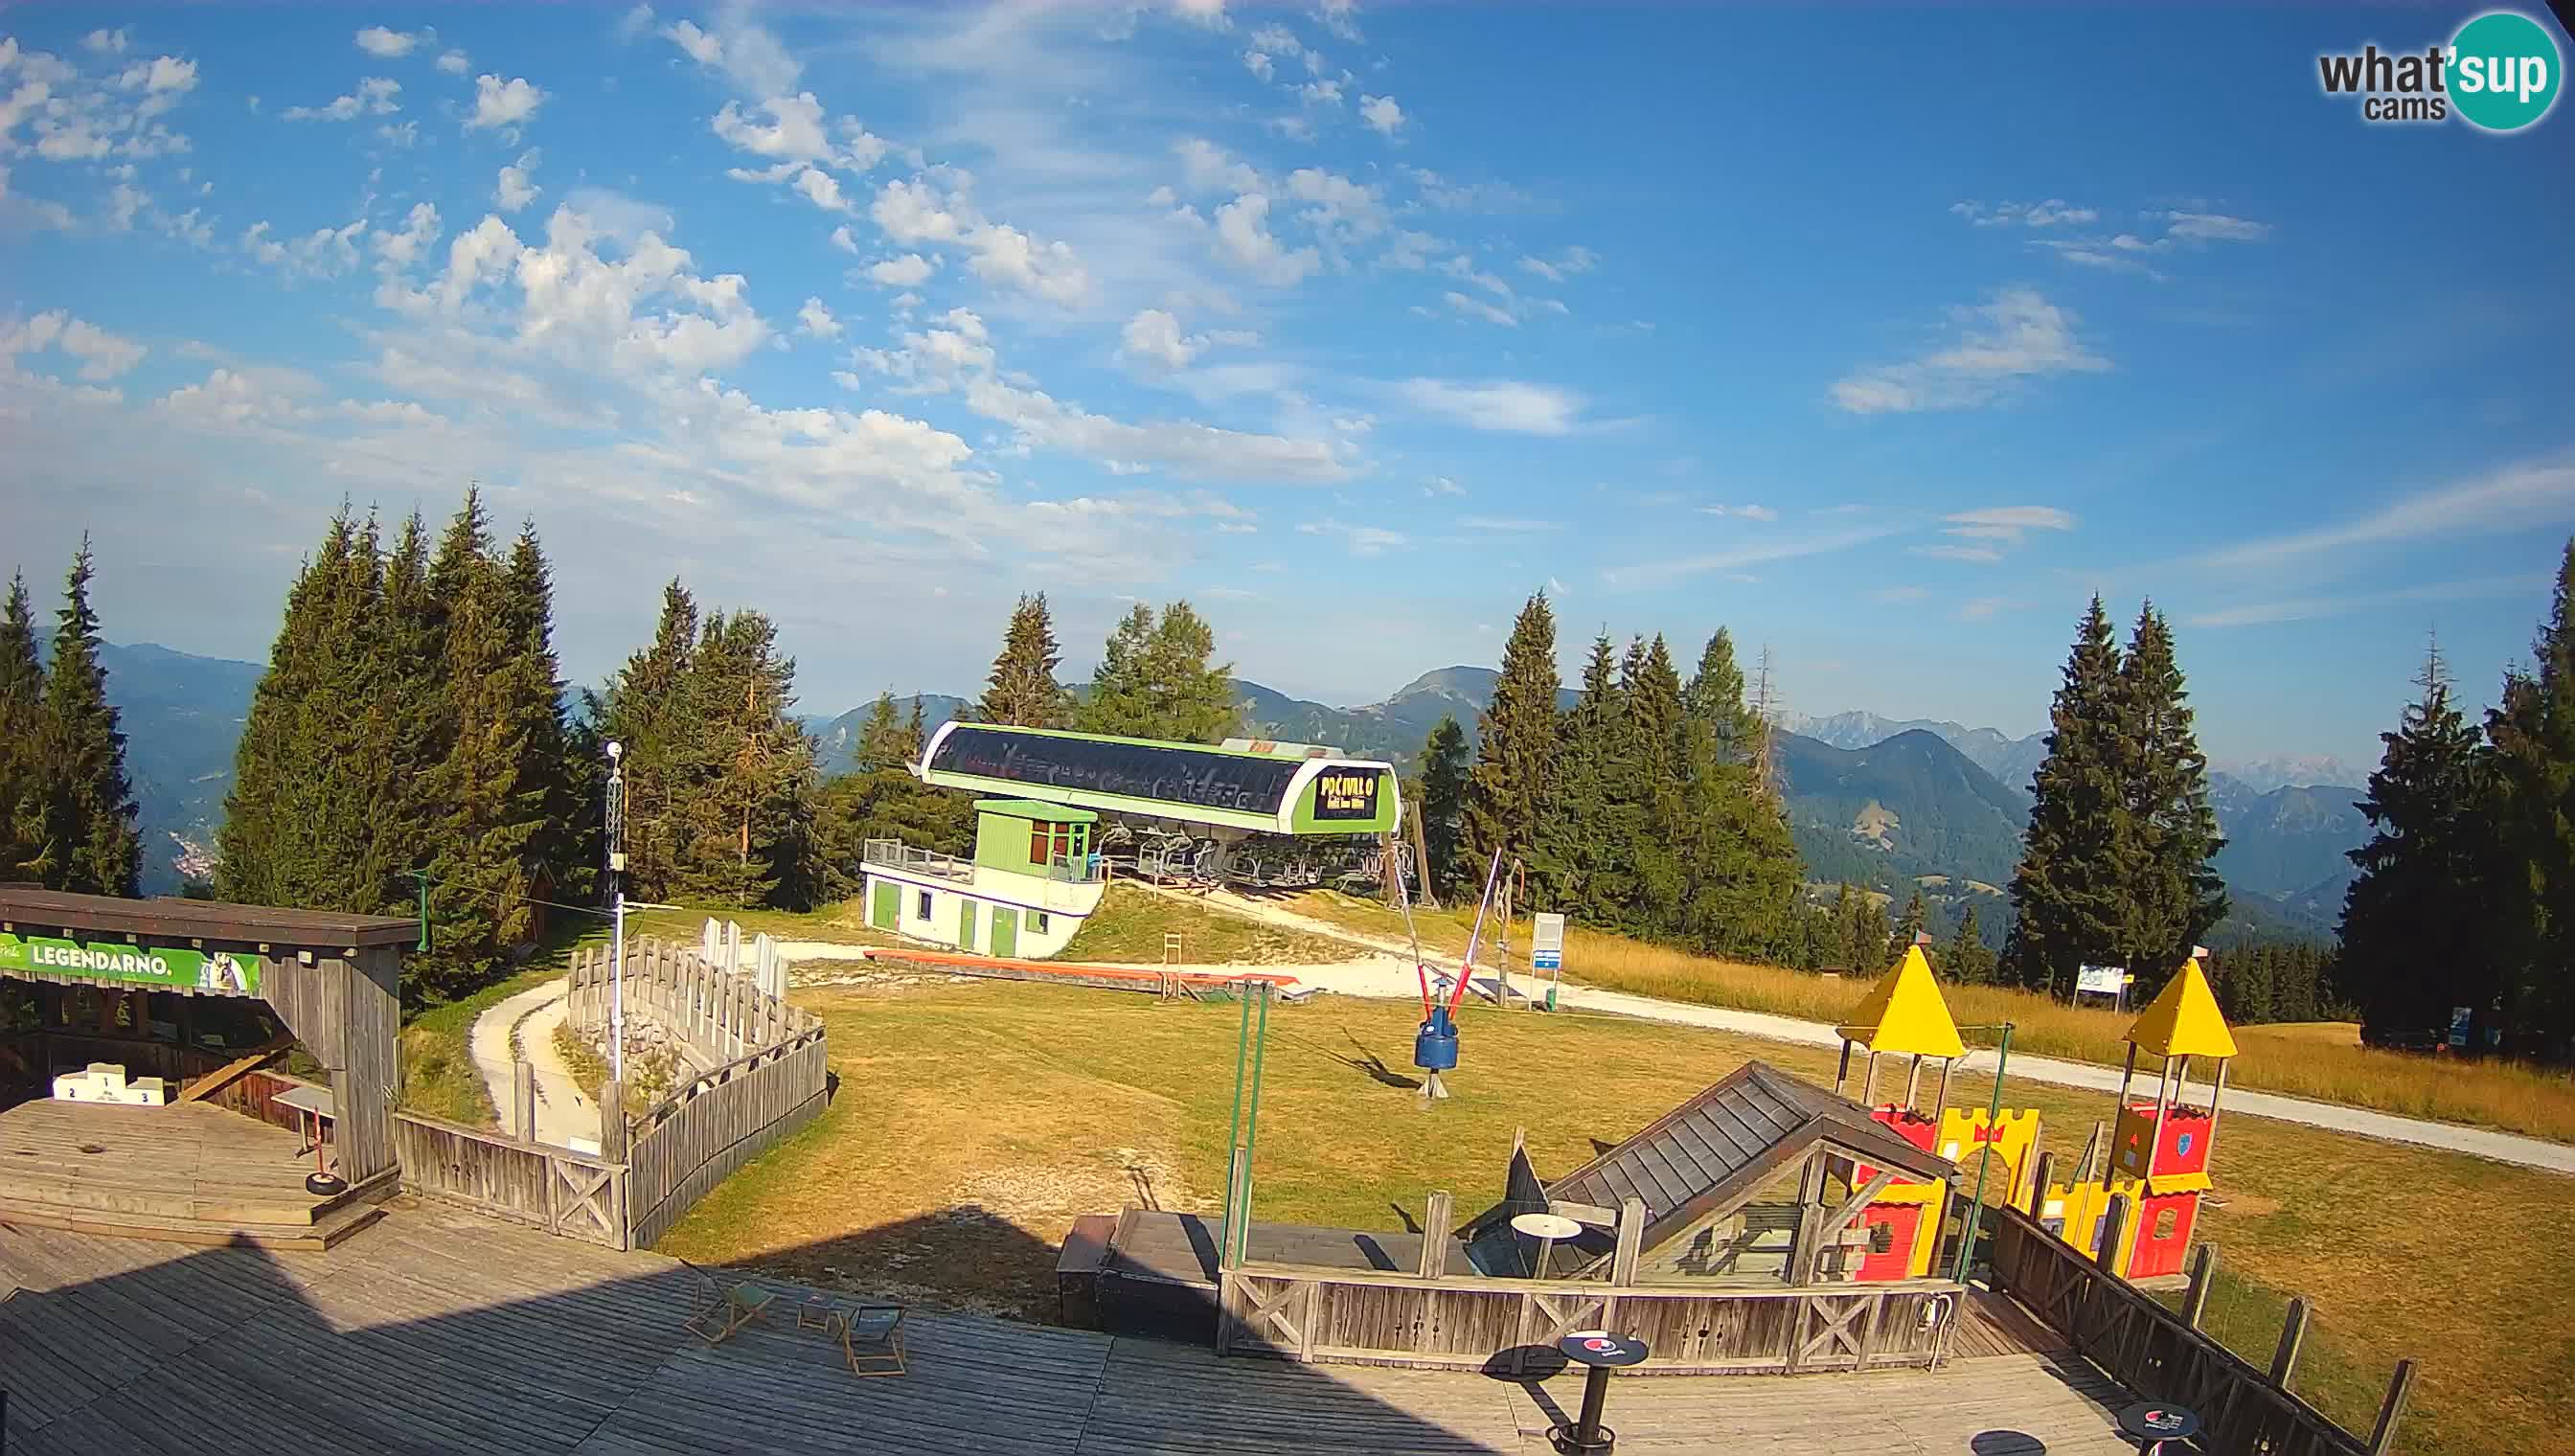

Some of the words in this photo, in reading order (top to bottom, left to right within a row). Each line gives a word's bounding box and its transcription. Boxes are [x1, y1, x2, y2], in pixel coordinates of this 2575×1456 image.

[33, 945, 172, 976] LEGENDARNO.
[103, 1077, 108, 1086] 1
[69, 1088, 75, 1098] 2
[142, 1093, 148, 1103] 3
